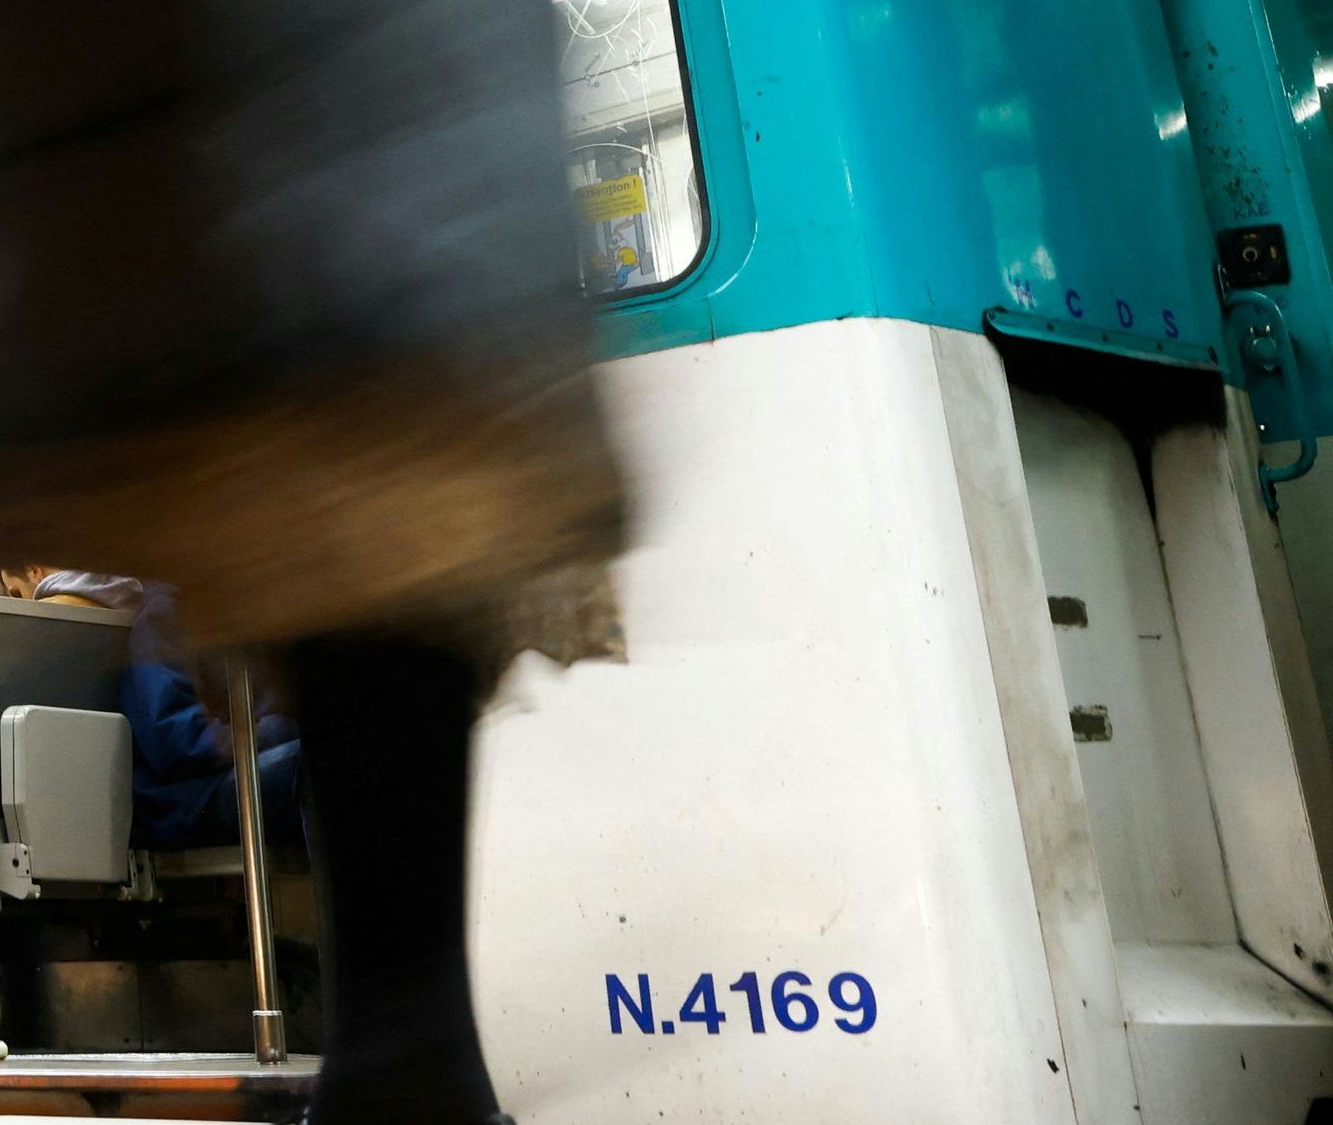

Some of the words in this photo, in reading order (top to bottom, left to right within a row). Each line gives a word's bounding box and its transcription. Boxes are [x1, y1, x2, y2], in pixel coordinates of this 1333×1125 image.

[1065, 289, 1084, 319] C
[1116, 300, 1134, 329] D
[1162, 309, 1180, 339] S
[605, 971, 878, 1035] N.4169
